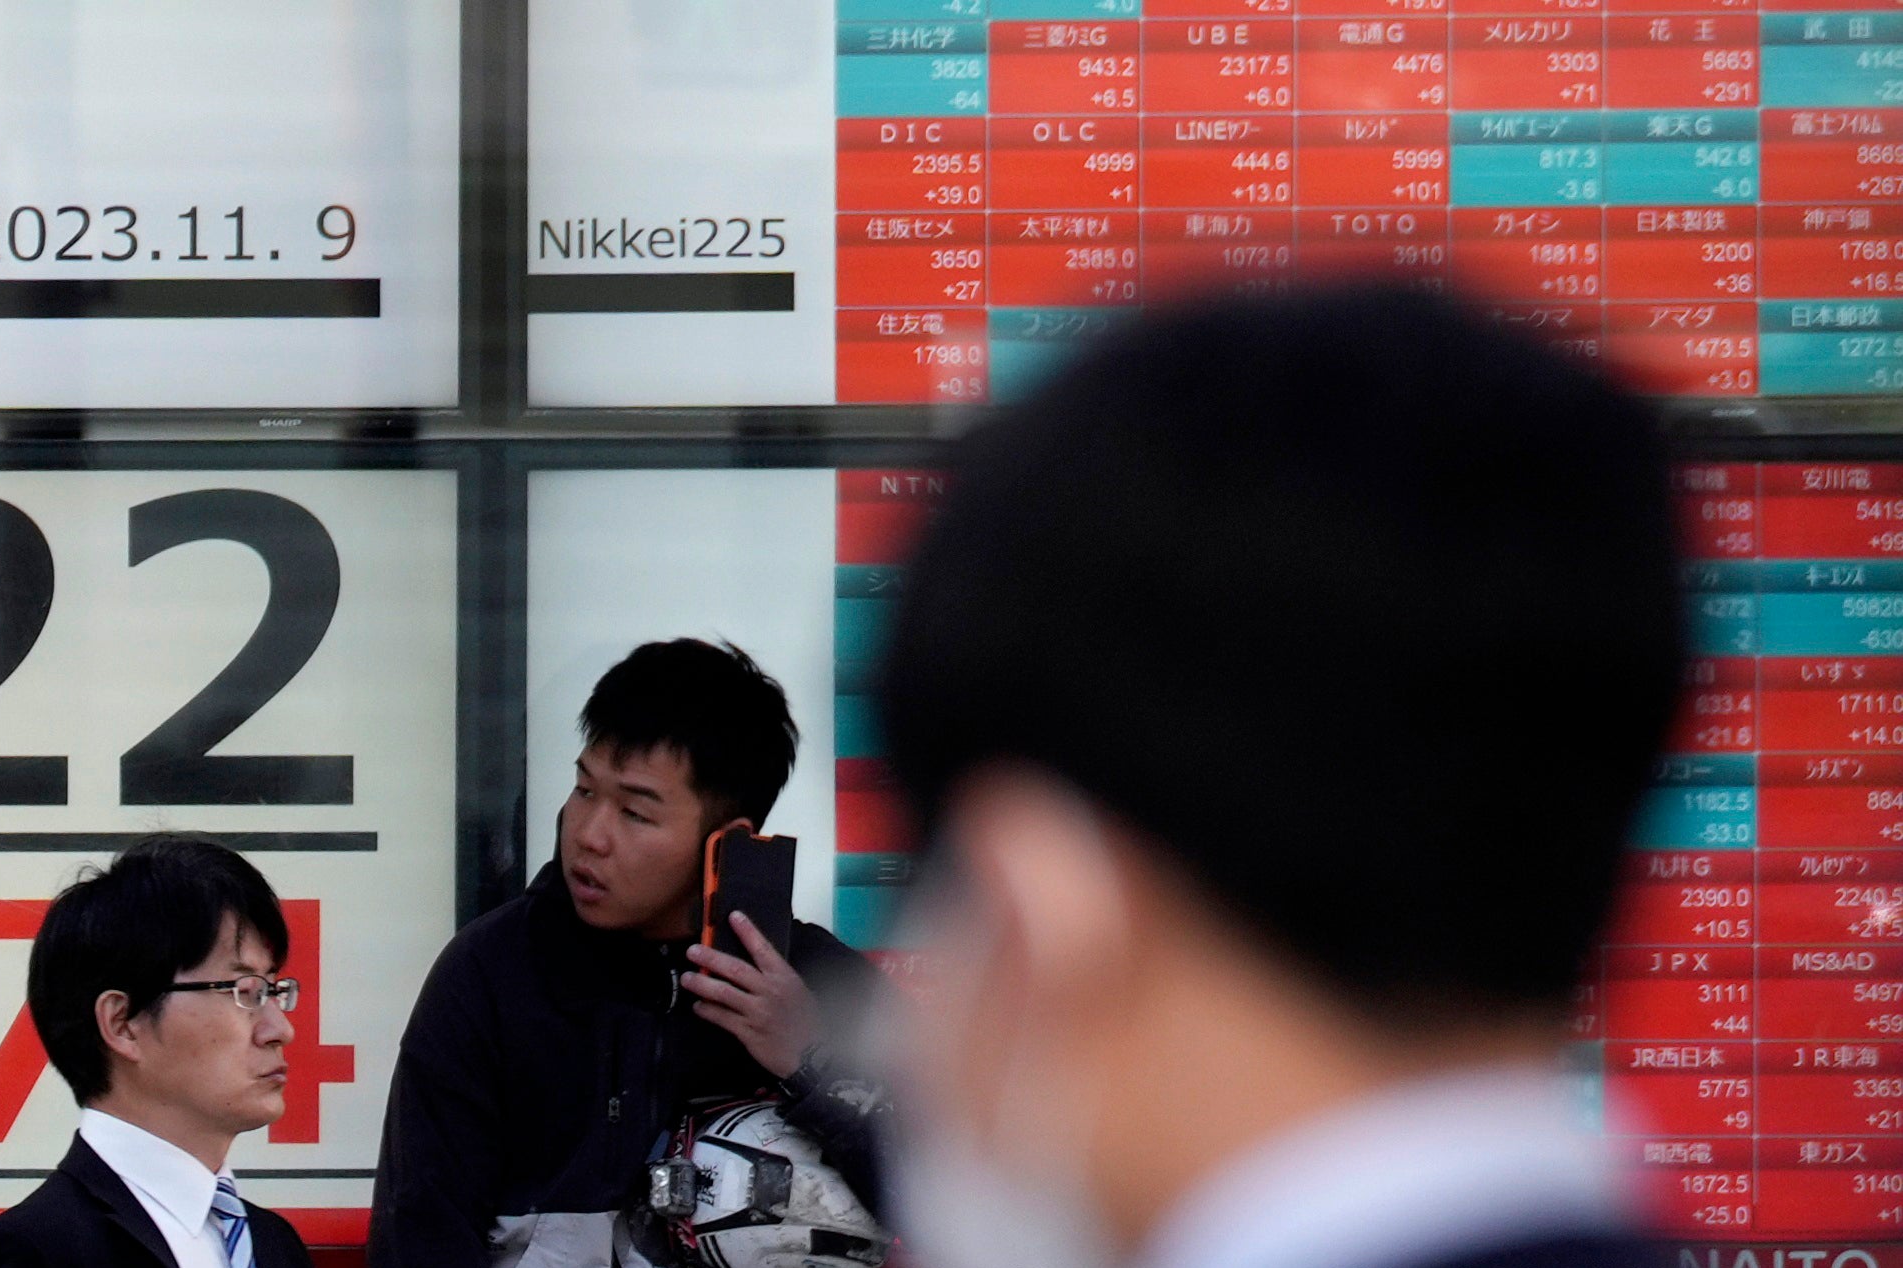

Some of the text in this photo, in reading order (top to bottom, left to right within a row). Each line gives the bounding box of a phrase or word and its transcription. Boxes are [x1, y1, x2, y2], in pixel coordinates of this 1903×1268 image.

[865, 27, 955, 51] 三井化学
[1187, 24, 1249, 46] UBE
[1339, 22, 1405, 44] 電通G
[1484, 20, 1573, 43] メルカリ
[1078, 56, 1136, 78] 943.2
[1219, 54, 1290, 77] 2317.5
[1392, 53, 1445, 74] 4476
[1547, 51, 1599, 73] 3303
[1702, 49, 1754, 71] 5663
[943, 90, 981, 110] -64
[1091, 87, 1137, 109] +6.5
[1244, 86, 1291, 107] +6.0
[1417, 84, 1445, 105] +9
[1559, 83, 1597, 103] +71
[1702, 81, 1753, 102] +291
[880, 122, 942, 144] DIC
[1032, 121, 1096, 143] OLC
[1175, 120, 1263, 141] LINEヤフー
[1345, 117, 1400, 140] トレンド
[1647, 116, 1713, 137] 楽天G
[912, 153, 983, 174] 2395.5
[1083, 152, 1136, 173] 4999
[1231, 150, 1290, 171] 444.6
[1392, 149, 1444, 170] 5999
[1539, 146, 1597, 169] 817.3
[924, 184, 983, 205] +39.0
[1109, 184, 1134, 203] +1
[1232, 182, 1290, 203] +13.0
[1392, 180, 1442, 202] +101
[1857, 174, 1903, 196] +267
[1331, 213, 1417, 235] TOTO
[1493, 211, 1562, 234] ガイシ
[1636, 209, 1726, 233] 日本製鉄
[1802, 208, 1871, 231] 神戸鋼
[315, 204, 358, 262] 9
[539, 217, 787, 260] Nikkei225
[930, 248, 982, 269] 3650
[1701, 241, 1754, 263] 3200
[1839, 240, 1903, 261] 1768.0
[943, 280, 982, 301] +27
[1091, 279, 1136, 300] +7.0
[1713, 273, 1753, 294] +36
[1850, 271, 1903, 292] +16.5
[876, 313, 945, 336] 住友電
[1022, 314, 1109, 336] フジク
[1492, 307, 1573, 328] ークマ
[1648, 305, 1716, 328] アマダ
[1790, 304, 1880, 328] 日本郵政
[913, 344, 982, 366] 1798.0
[1683, 337, 1753, 359] 1473.5
[1838, 336, 1903, 358] 1272.5
[1707, 369, 1753, 390] +3.0
[880, 475, 944, 495] NTN
[1802, 467, 1872, 490] 安川電
[1806, 565, 1865, 587] キーエンス
[1837, 693, 1903, 714] 1711.0
[1848, 725, 1903, 745] +14.0
[1806, 757, 1865, 780] シチズン
[1866, 790, 1903, 811] 884
[1648, 855, 1711, 879] 丸井G
[1798, 854, 1869, 877] クレセゾン
[1680, 887, 1750, 908] 2390.0
[1834, 886, 1903, 908] 2240.5
[1692, 918, 1750, 939] +10.5
[1649, 952, 1709, 972] JPX
[1792, 951, 1876, 972] MS&AD
[1698, 983, 1748, 1003] 3111
[1853, 982, 1903, 1003] 5497
[1710, 1015, 1749, 1033] +44
[1865, 1013, 1903, 1034] +59
[1629, 1046, 1726, 1068] JR西日本
[1792, 1045, 1879, 1068] JR東海
[1698, 1078, 1750, 1099] 5775
[1852, 1078, 1903, 1098] 3363
[1722, 1110, 1750, 1130] +9
[1865, 1109, 1902, 1129] +21
[1797, 1141, 1867, 1164] 東ガス
[1680, 1174, 1750, 1194] 1872.5
[1853, 1173, 1903, 1194] 3140
[1692, 1205, 1749, 1225] +25.0
